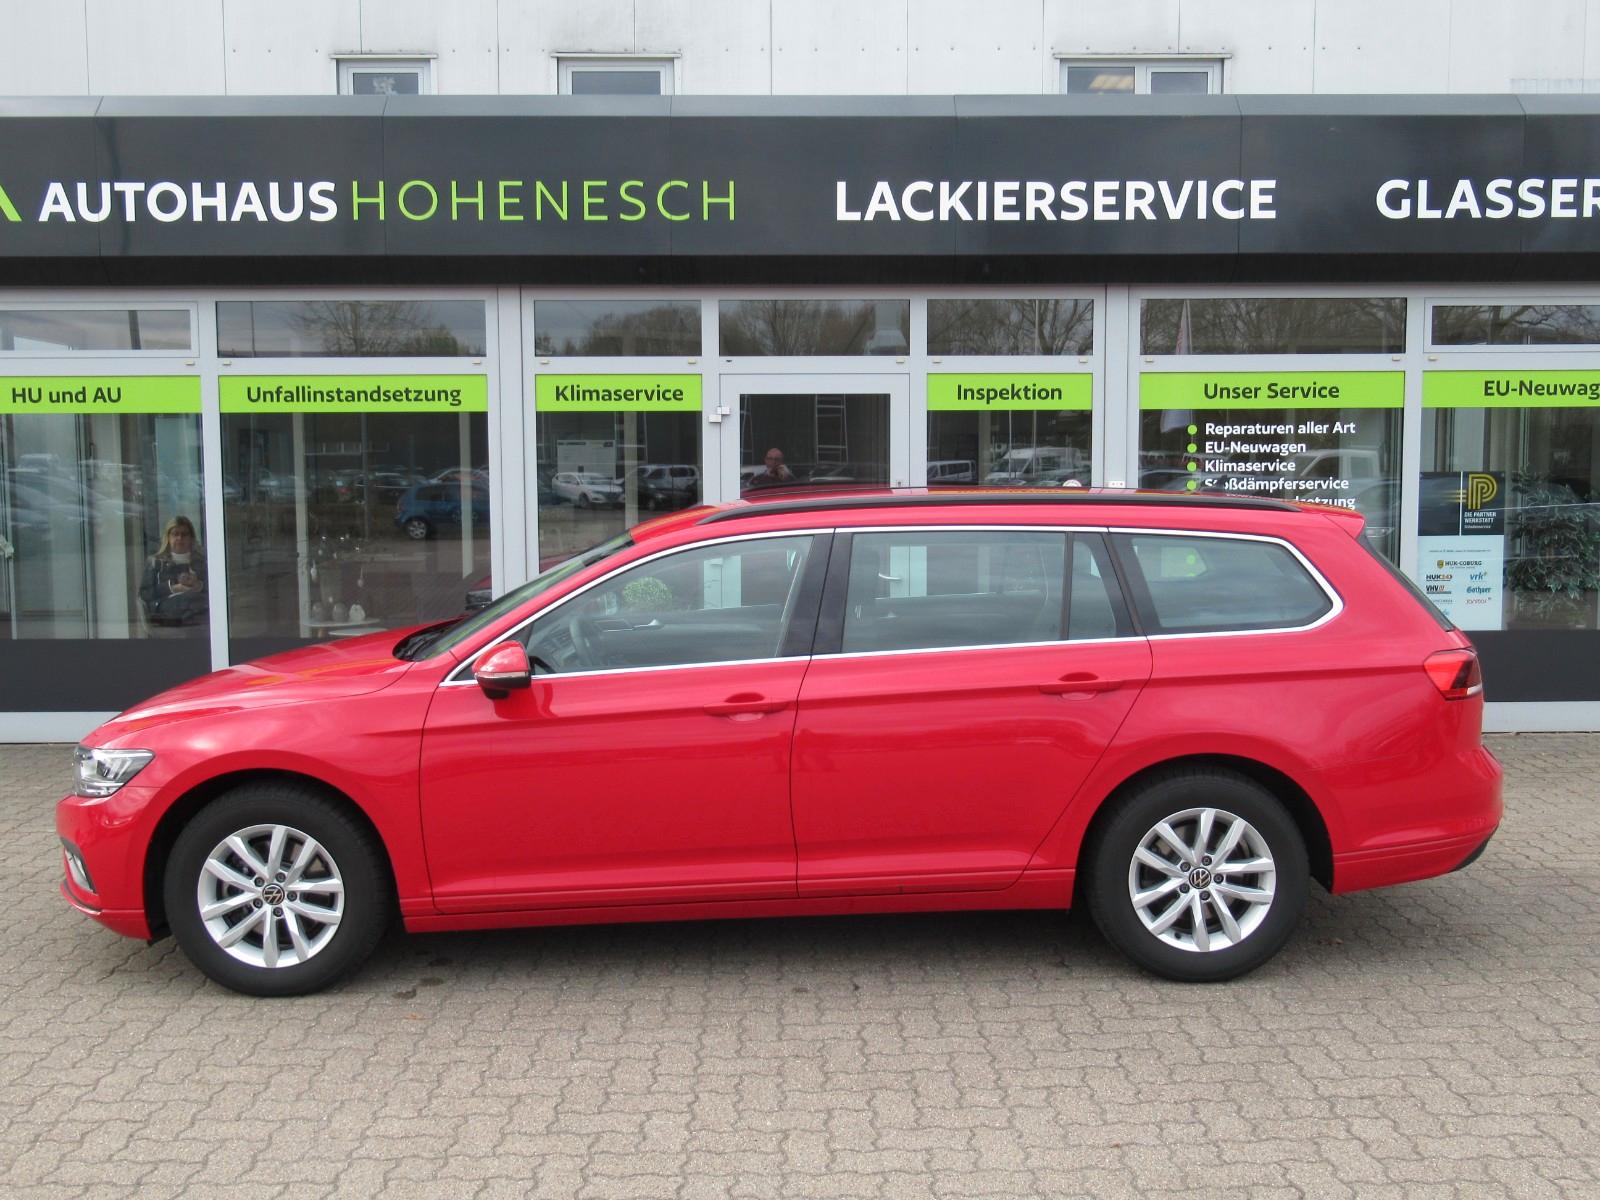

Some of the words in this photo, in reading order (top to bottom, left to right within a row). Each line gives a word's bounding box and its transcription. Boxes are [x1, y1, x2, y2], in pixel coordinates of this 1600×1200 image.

[39, 182, 337, 222] AUTOHAUS
[352, 180, 735, 221] HOHENESCH
[837, 180, 1276, 221] LACKIERSERVICE
[1377, 179, 1600, 218] GLASSER
[13, 388, 41, 403] HU
[49, 387, 86, 403] und
[94, 388, 121, 402] AU
[248, 386, 461, 406] Unfallinstandsetzung
[556, 385, 683, 401] Klimaservice
[958, 384, 1061, 404] Inspektion
[1205, 384, 1261, 399] Unser
[1268, 382, 1339, 398] Service
[1485, 381, 1600, 400] EU-Neuwag
[1206, 423, 1293, 437] Reparaturen
[1298, 422, 1329, 433] aller
[1333, 422, 1355, 433] Art
[1206, 442, 1306, 456] EU-Neuwagen
[1206, 459, 1295, 471] Klimaservice
[1205, 477, 1349, 492] Sßdämpferservice
